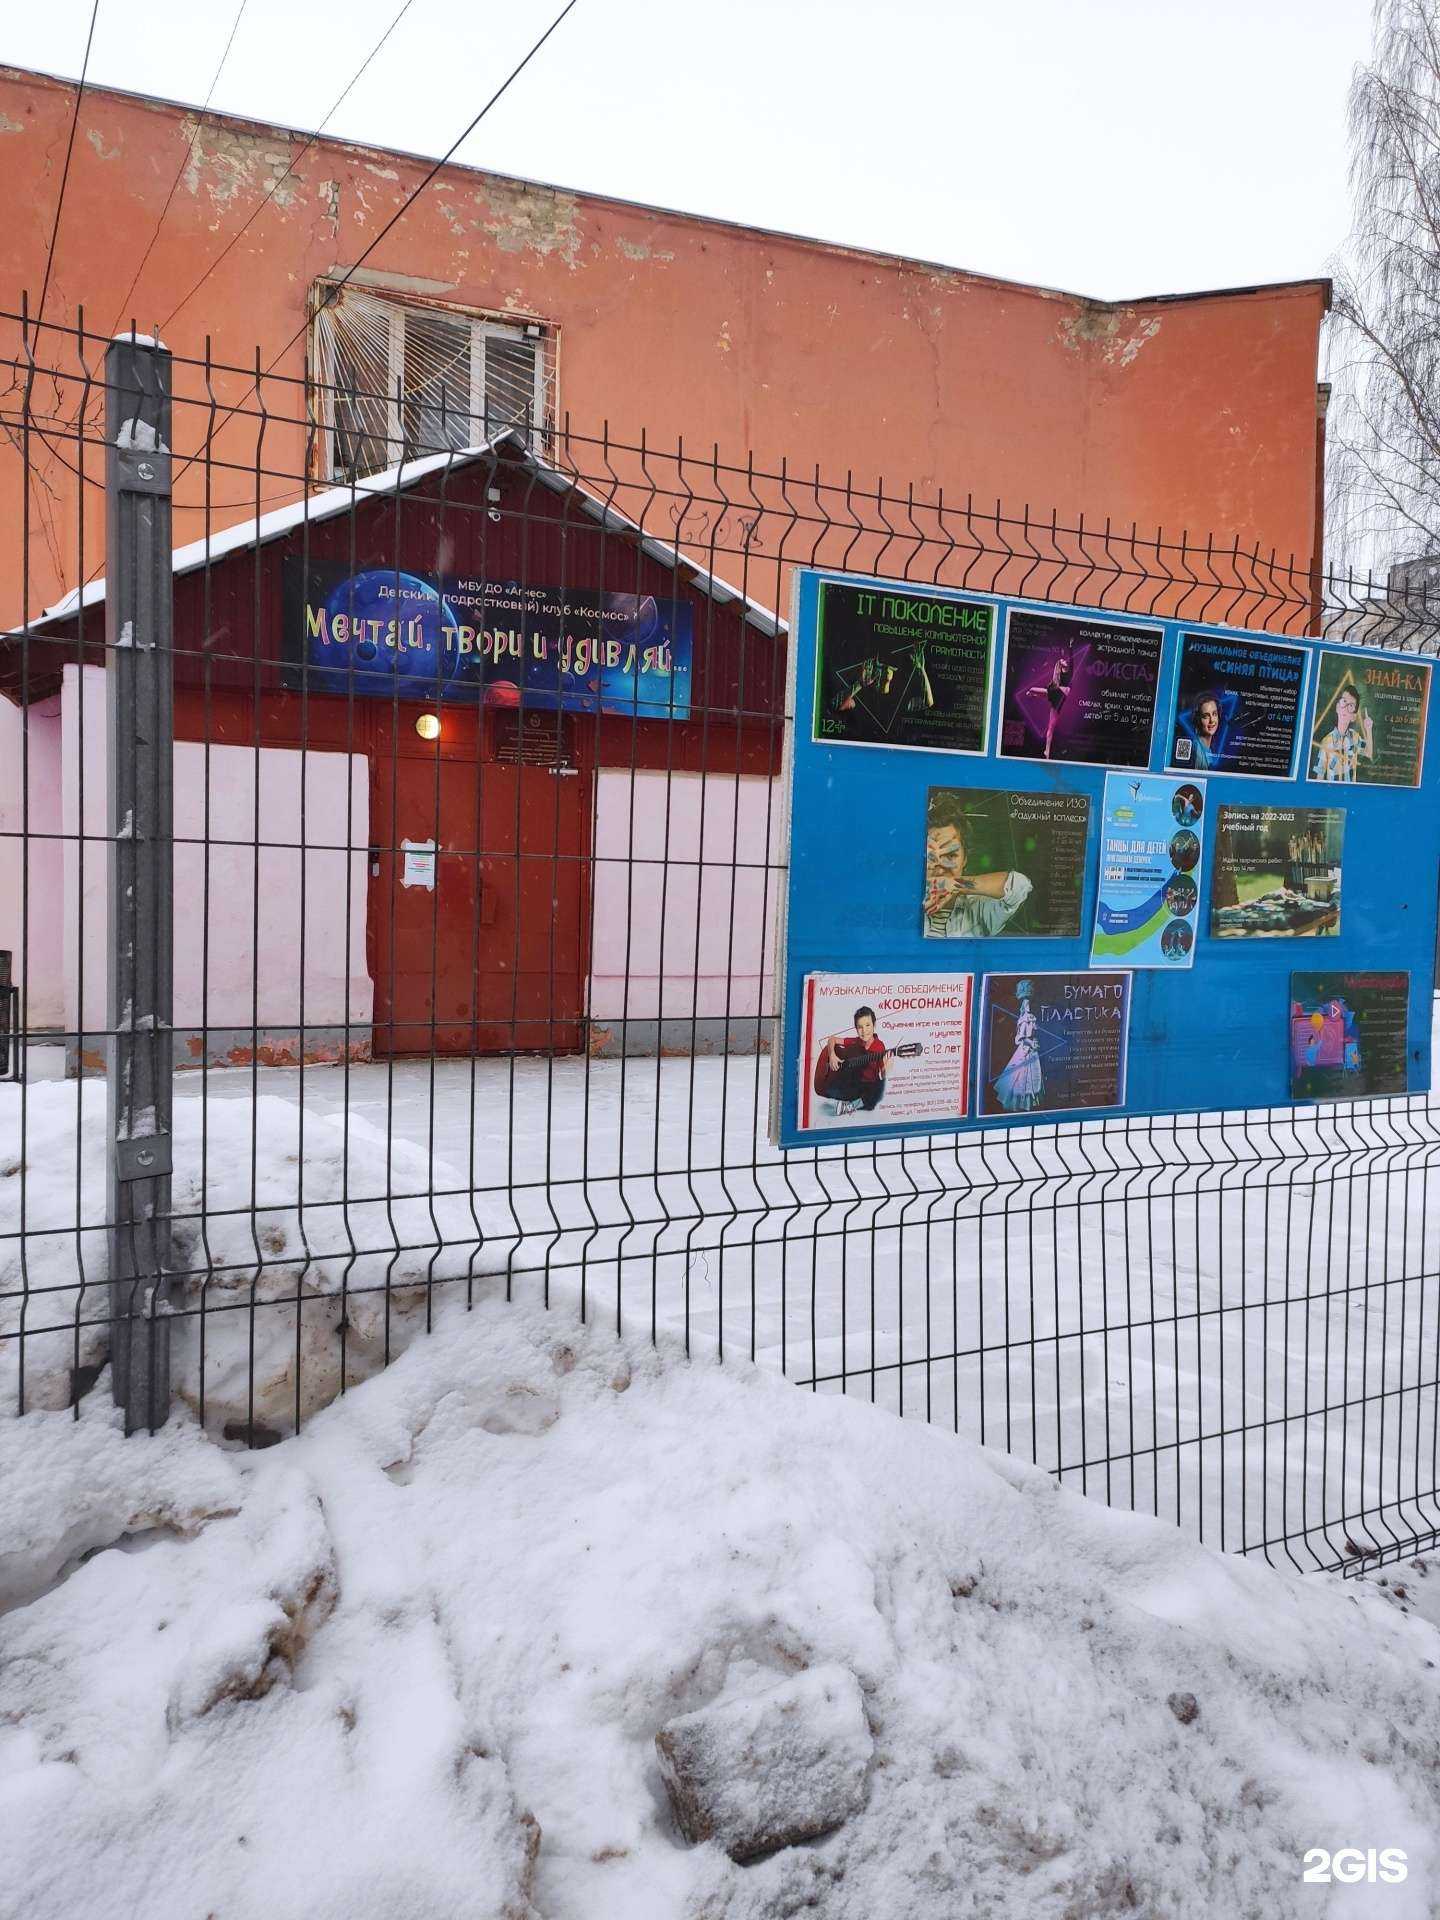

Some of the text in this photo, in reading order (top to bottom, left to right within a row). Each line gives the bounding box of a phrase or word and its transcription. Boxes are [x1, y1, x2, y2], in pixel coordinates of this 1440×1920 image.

[458, 580, 482, 592] МБУ
[484, 583, 502, 595] ДО
[438, 593, 540, 614] подростковый)
[543, 604, 571, 617] клуб
[574, 605, 629, 621] «Космос»
[856, 593, 988, 631] IT ПОКОЛЕНИЕ
[306, 603, 432, 652] Мечтай,
[441, 625, 522, 664] твори
[533, 633, 547, 660] и
[873, 622, 987, 646] ПОВЫШЕНИЕ КОМПЬЮТЕРНОЙ
[1079, 629, 1159, 646] коллектив современного
[930, 644, 986, 660] ГРАМОТНОСТИ
[1097, 644, 1136, 656] эстрадного
[1188, 642, 1248, 658] МУЗЫКАЛЬНОЕ
[1086, 659, 1154, 682] «ФИЕСТА»
[1213, 660, 1300, 683] «СИНЯЯ ПТИЦА»
[1365, 668, 1423, 691] ЗНАЙ-КА
[1114, 712, 1119, 722] 5
[1010, 793, 1087, 809] Объединение ИЗО
[1009, 808, 1051, 824] «Радужный
[1223, 811, 1249, 821] Запись
[1260, 812, 1295, 822] 2022-2023
[1222, 822, 1269, 833] учебный год
[1106, 839, 1167, 855] ТАНЦЫ ДЛЯ ДЕТЕЙ
[819, 983, 964, 996] МУЗЫКАЛЬНОЕ ОБЪЕДИНЕНИЕ
[1063, 984, 1123, 999] БУМАГО
[878, 996, 963, 1011] «КОНСОНАНС»
[1040, 1005, 1121, 1022] ПЛАСТИКА
[881, 1020, 915, 1030] Обучение
[915, 1020, 932, 1029] игре
[924, 1044, 961, 1055] с 12 лет
